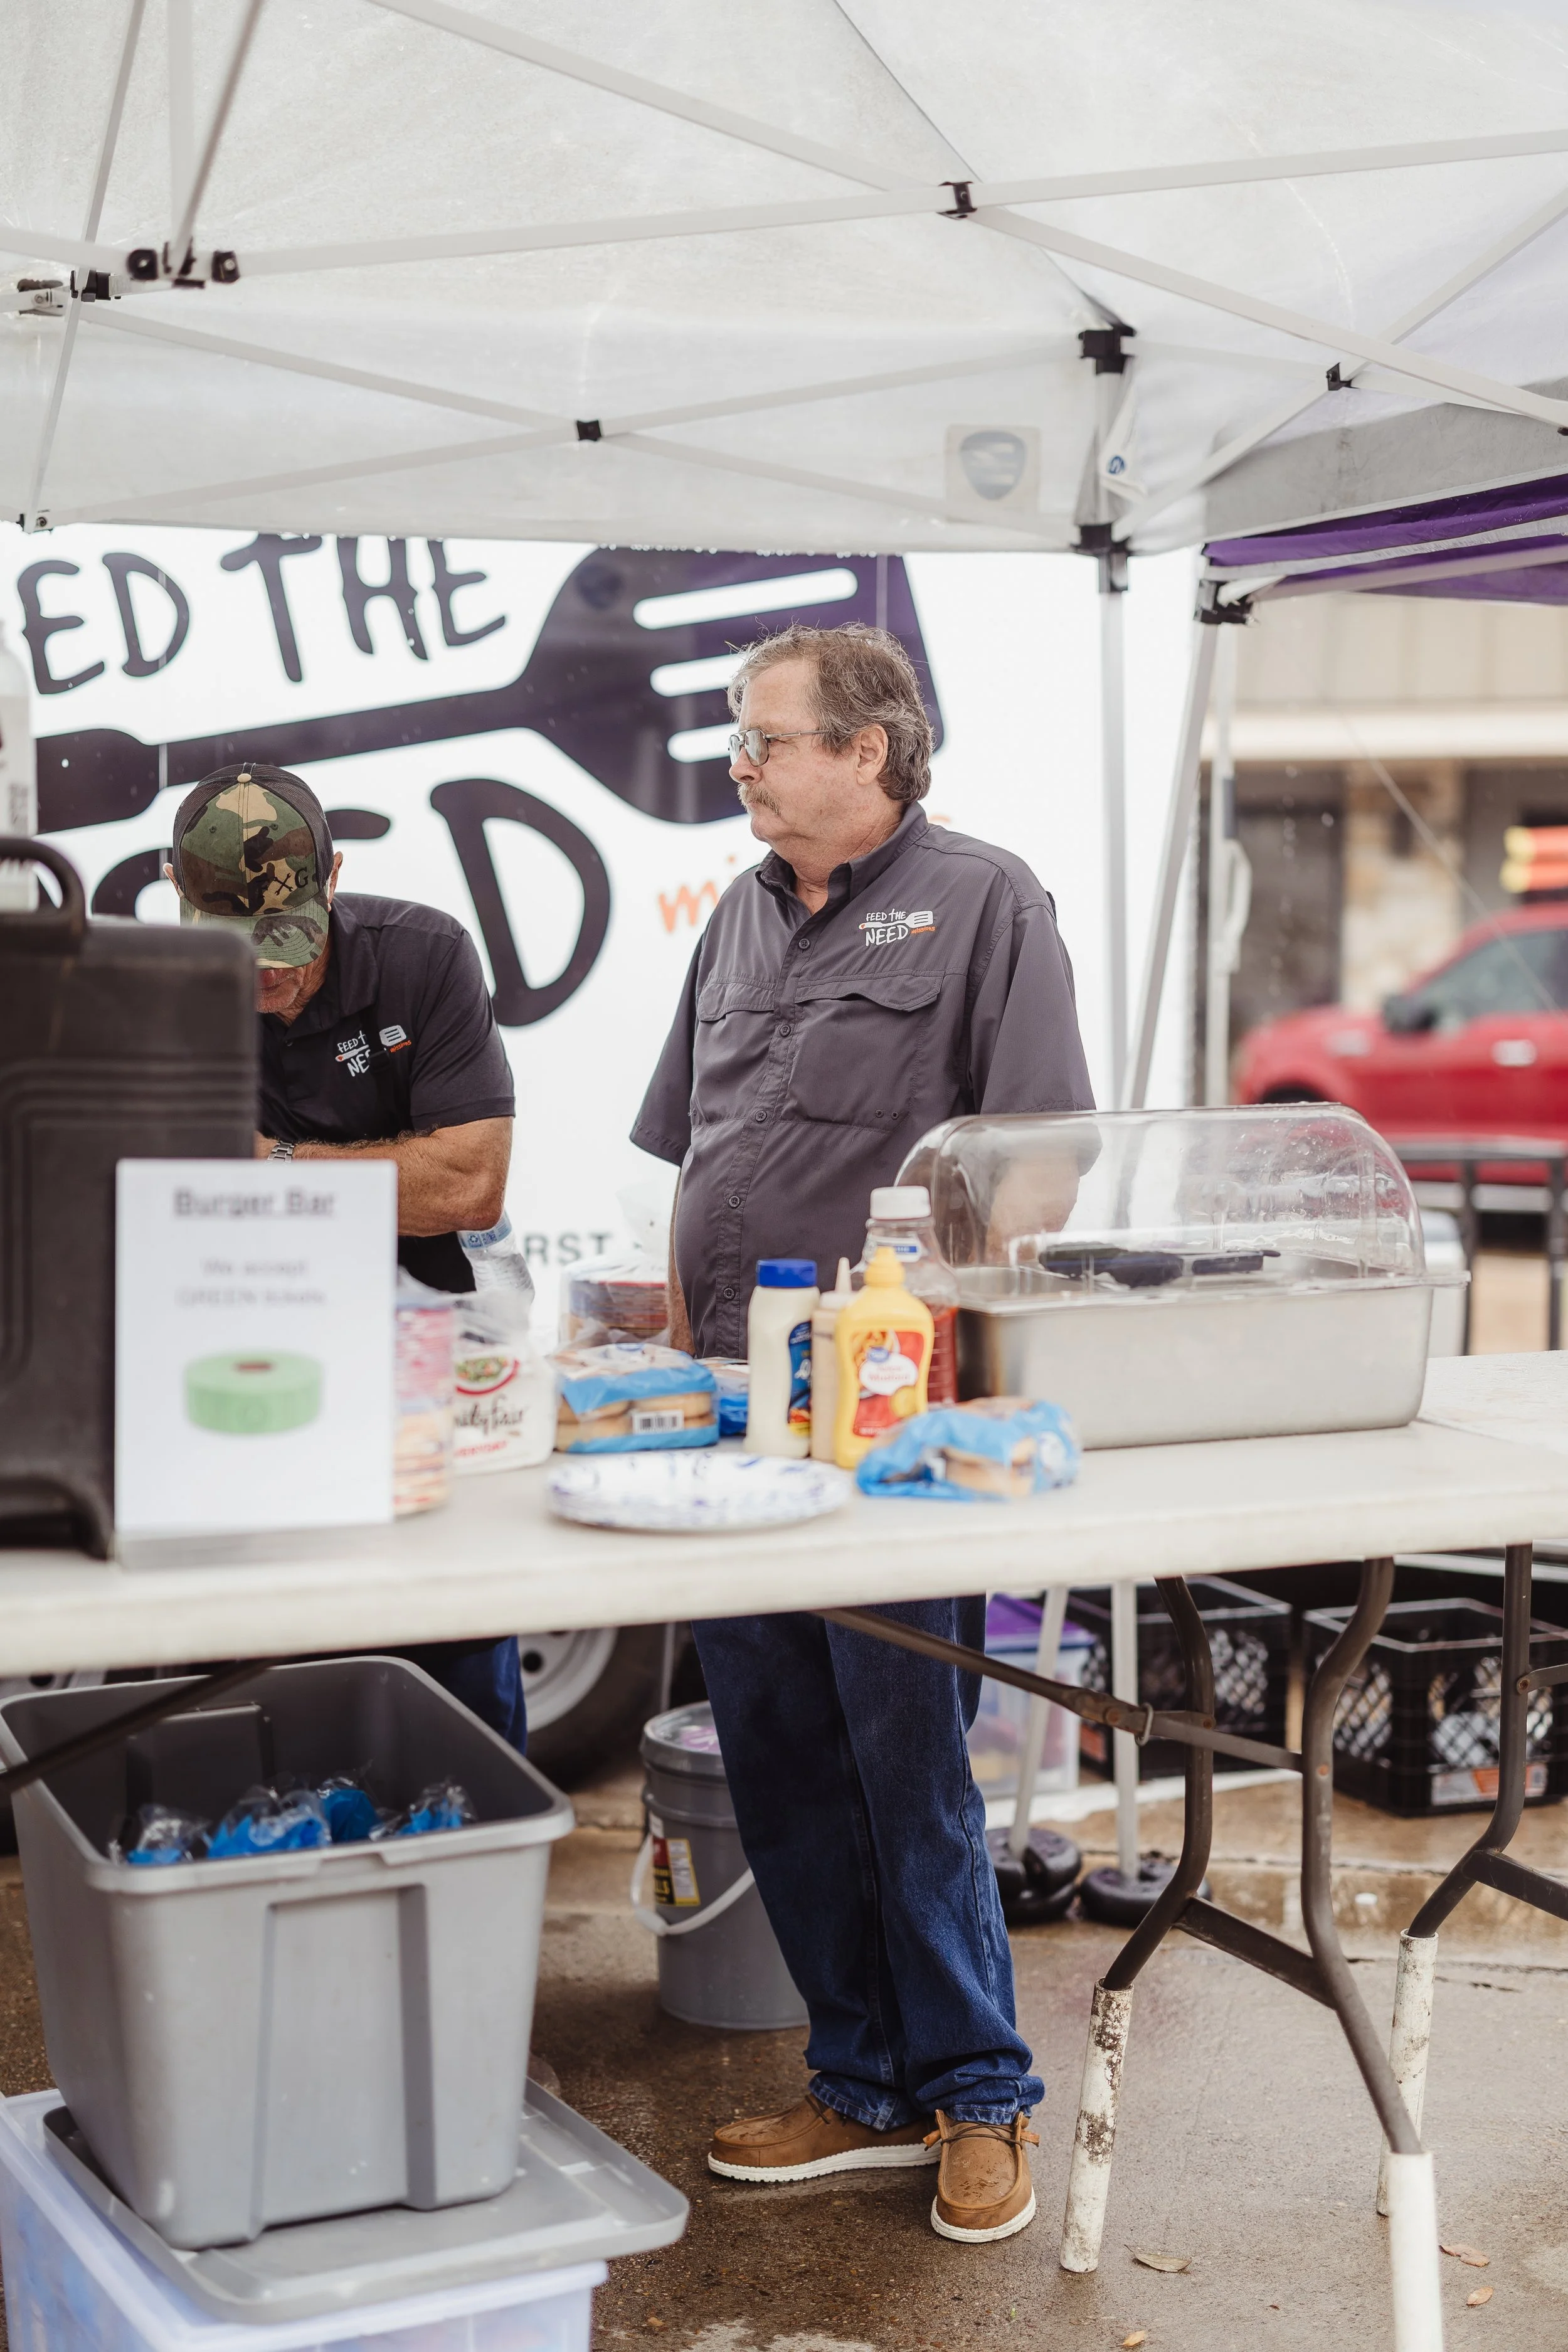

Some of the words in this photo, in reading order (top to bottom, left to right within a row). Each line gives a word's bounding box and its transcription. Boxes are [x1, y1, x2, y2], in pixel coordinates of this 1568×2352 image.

[220, 533, 506, 682] THE
[866, 912, 887, 921] FEED
[889, 908, 906, 922] THE
[866, 924, 908, 946] NEED
[911, 926, 936, 935] missions
[337, 1038, 359, 1053] FEED
[390, 1040, 412, 1053] missions
[347, 1049, 371, 1077] NE
[524, 1231, 613, 1267] RST
